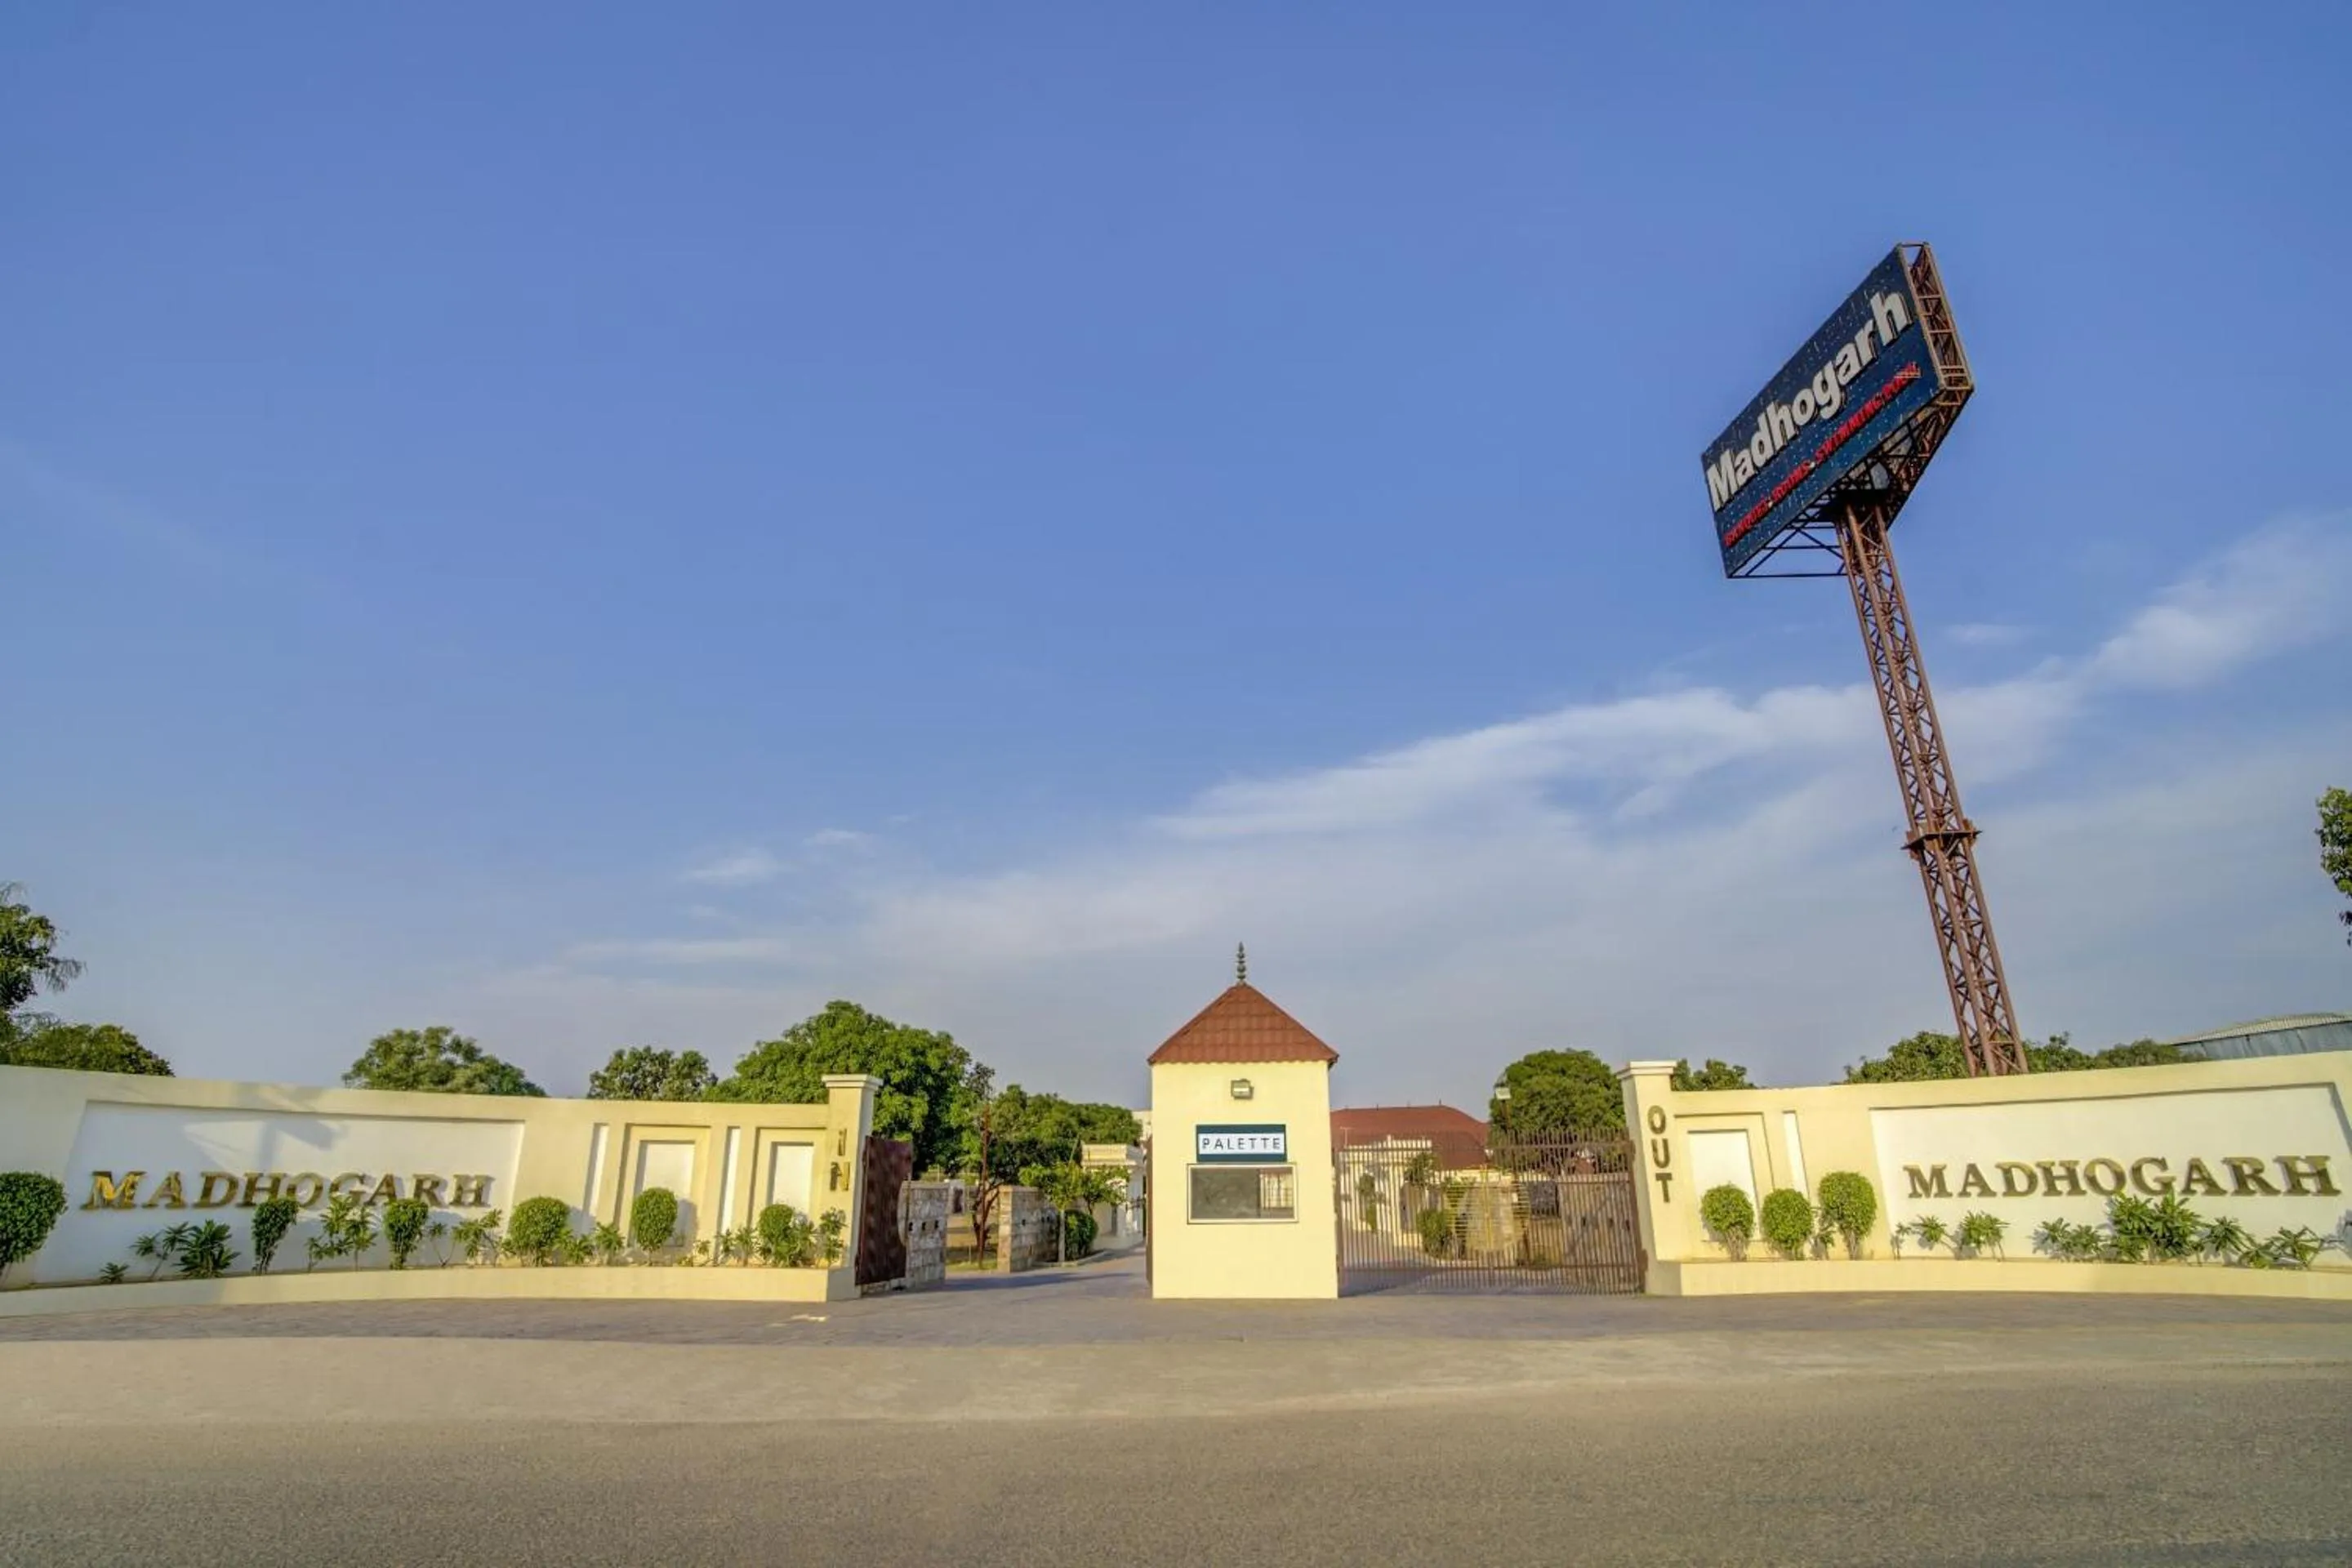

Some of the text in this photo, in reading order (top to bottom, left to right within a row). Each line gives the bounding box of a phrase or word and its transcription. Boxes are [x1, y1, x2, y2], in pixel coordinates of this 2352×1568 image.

[1706, 289, 1913, 513] Madhogarh
[1201, 1137, 1281, 1151] PALETTE
[1647, 1105, 1673, 1204] OUT
[80, 1169, 495, 1211] MADHOGARH
[1902, 1155, 2342, 1199] MADHOGARH
